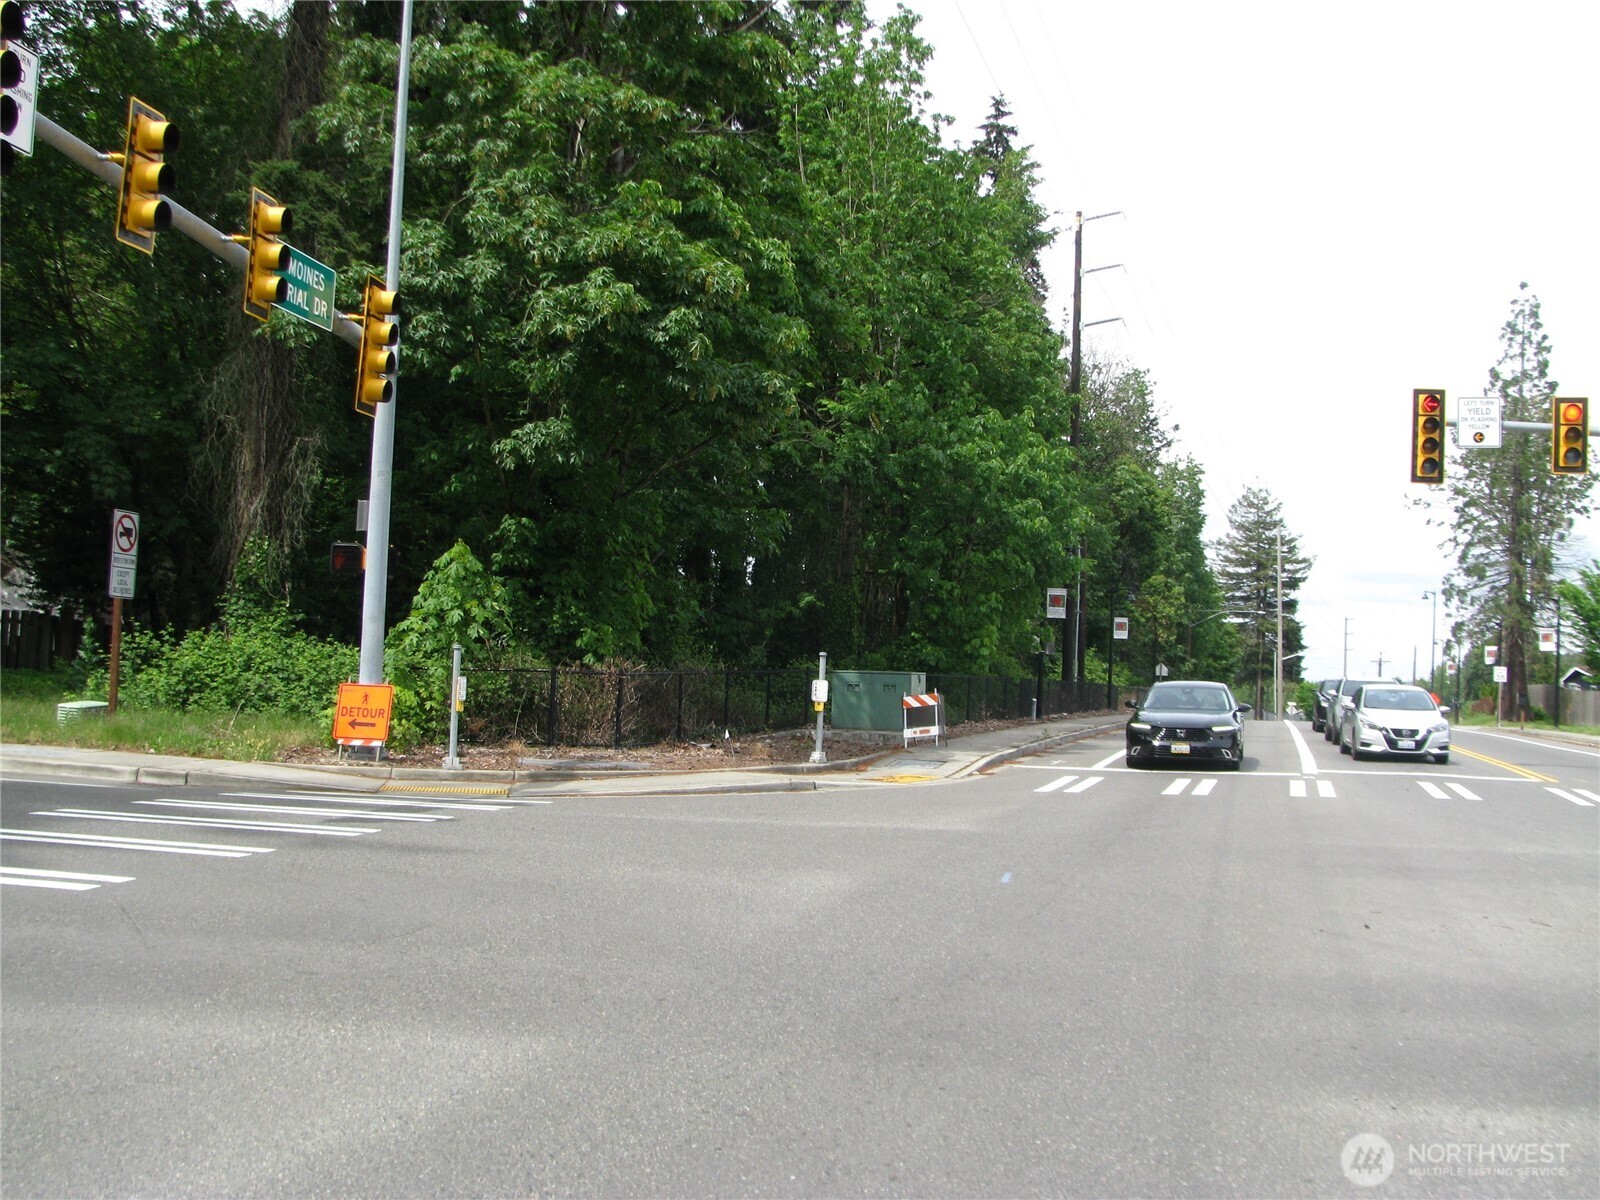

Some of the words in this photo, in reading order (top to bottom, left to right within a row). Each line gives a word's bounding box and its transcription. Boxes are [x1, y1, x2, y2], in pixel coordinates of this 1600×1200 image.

[288, 257, 325, 292] MOINES
[313, 296, 328, 320] DR
[1467, 407, 1492, 416] YIELD
[340, 706, 385, 719] DETOUR
